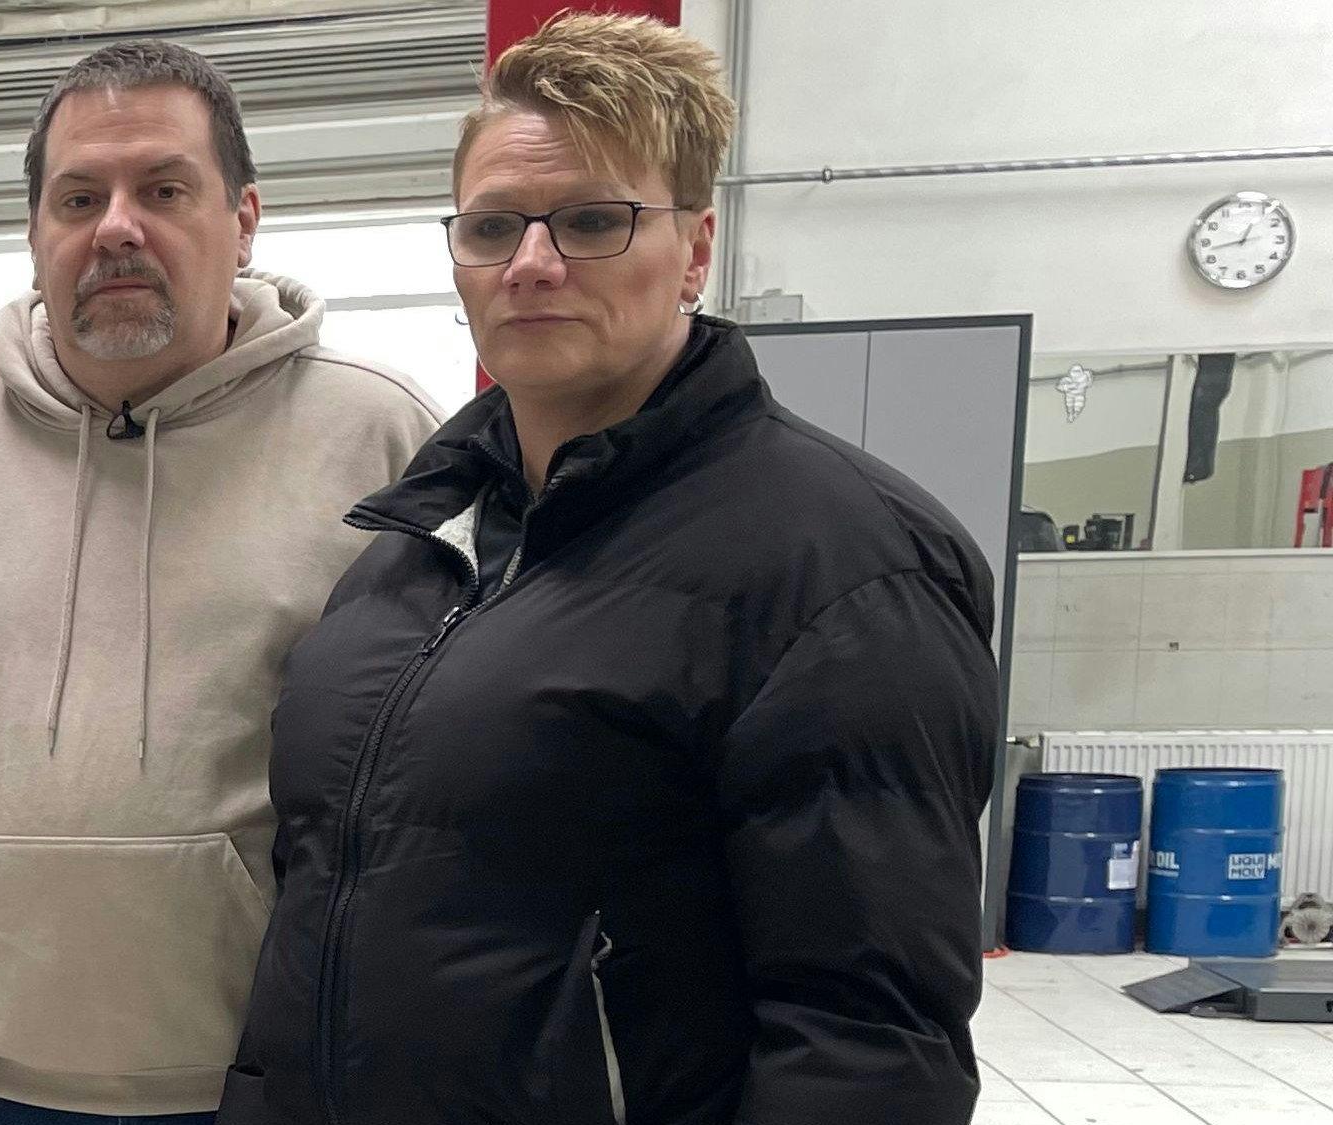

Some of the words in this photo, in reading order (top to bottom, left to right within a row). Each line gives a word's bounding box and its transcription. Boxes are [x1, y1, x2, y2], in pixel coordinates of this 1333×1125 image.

[1156, 851, 1180, 870] OIL
[1231, 855, 1265, 866] LIQUI
[1230, 867, 1264, 878] MOLY
